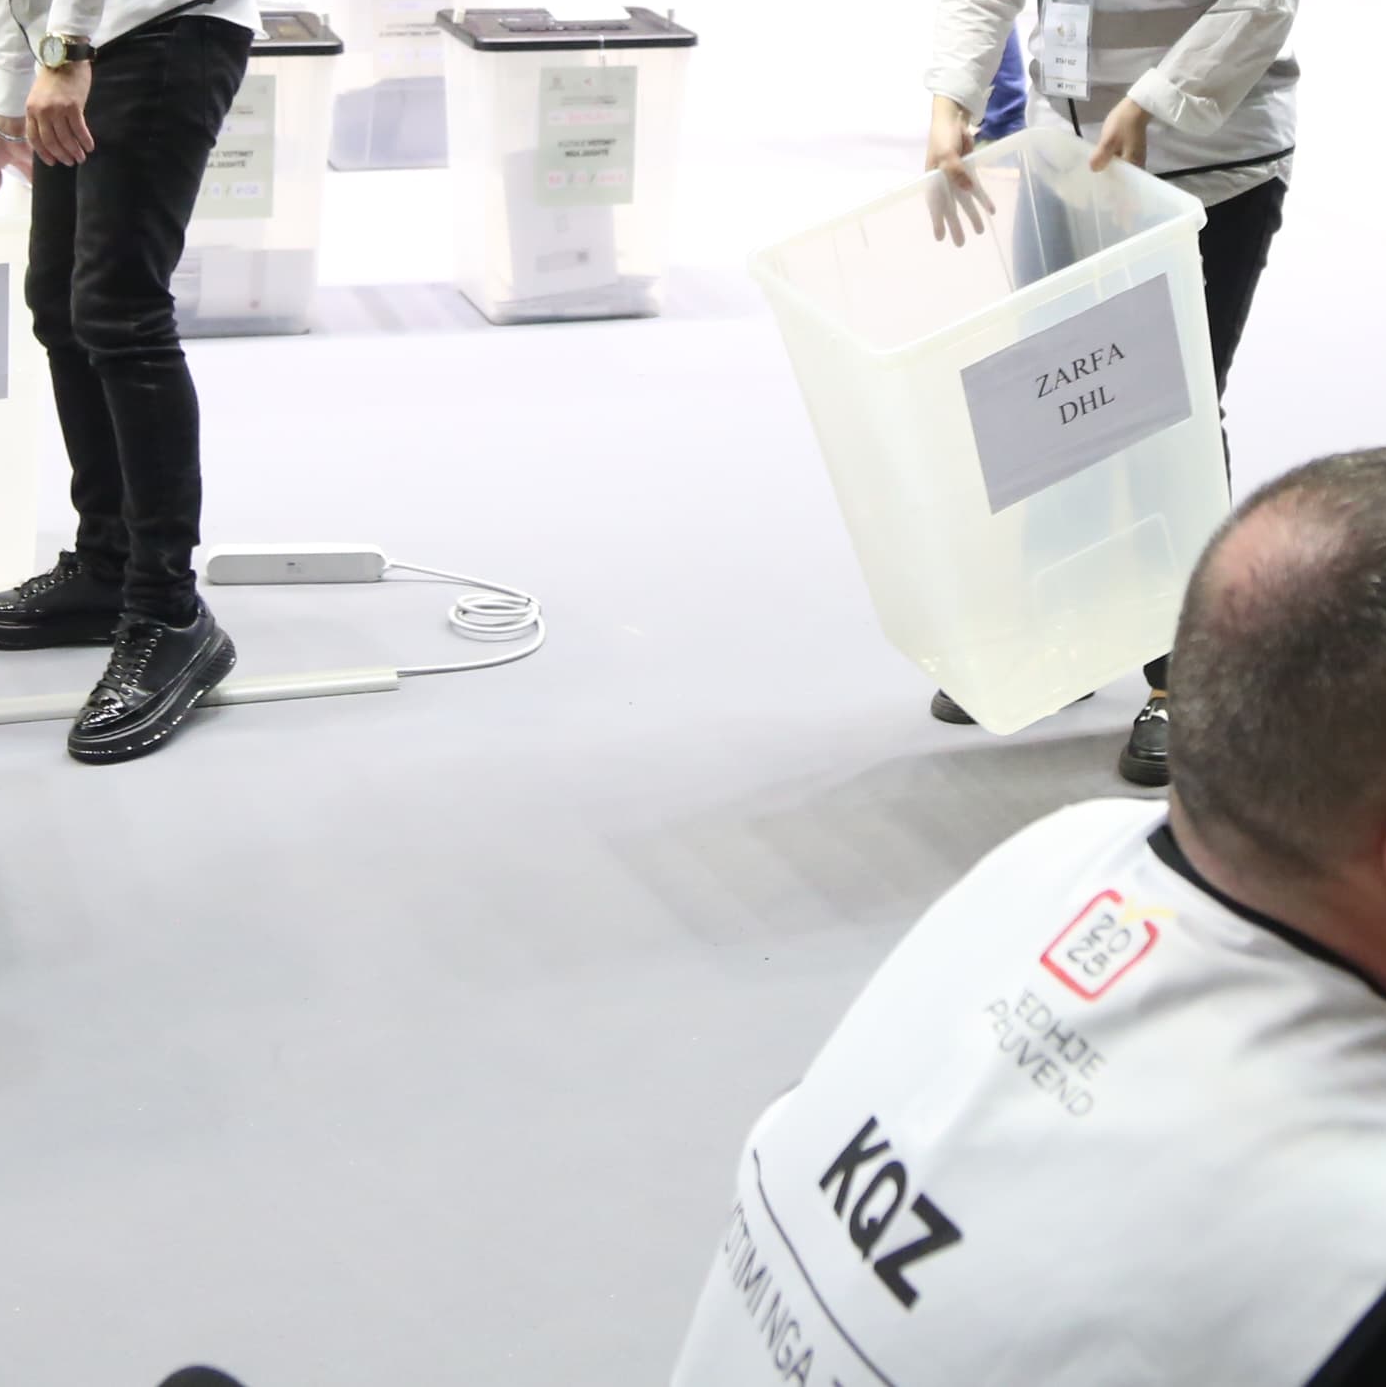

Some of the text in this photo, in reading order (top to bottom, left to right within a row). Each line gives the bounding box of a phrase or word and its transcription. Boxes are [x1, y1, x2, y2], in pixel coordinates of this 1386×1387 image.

[1035, 342, 1125, 399] ZARFA
[1059, 386, 1115, 425] DHL
[1090, 913, 1131, 954] 20
[1015, 989, 1107, 1080] EDHJE
[819, 1115, 963, 1312] KQZ
[760, 1292, 814, 1387] NGA
